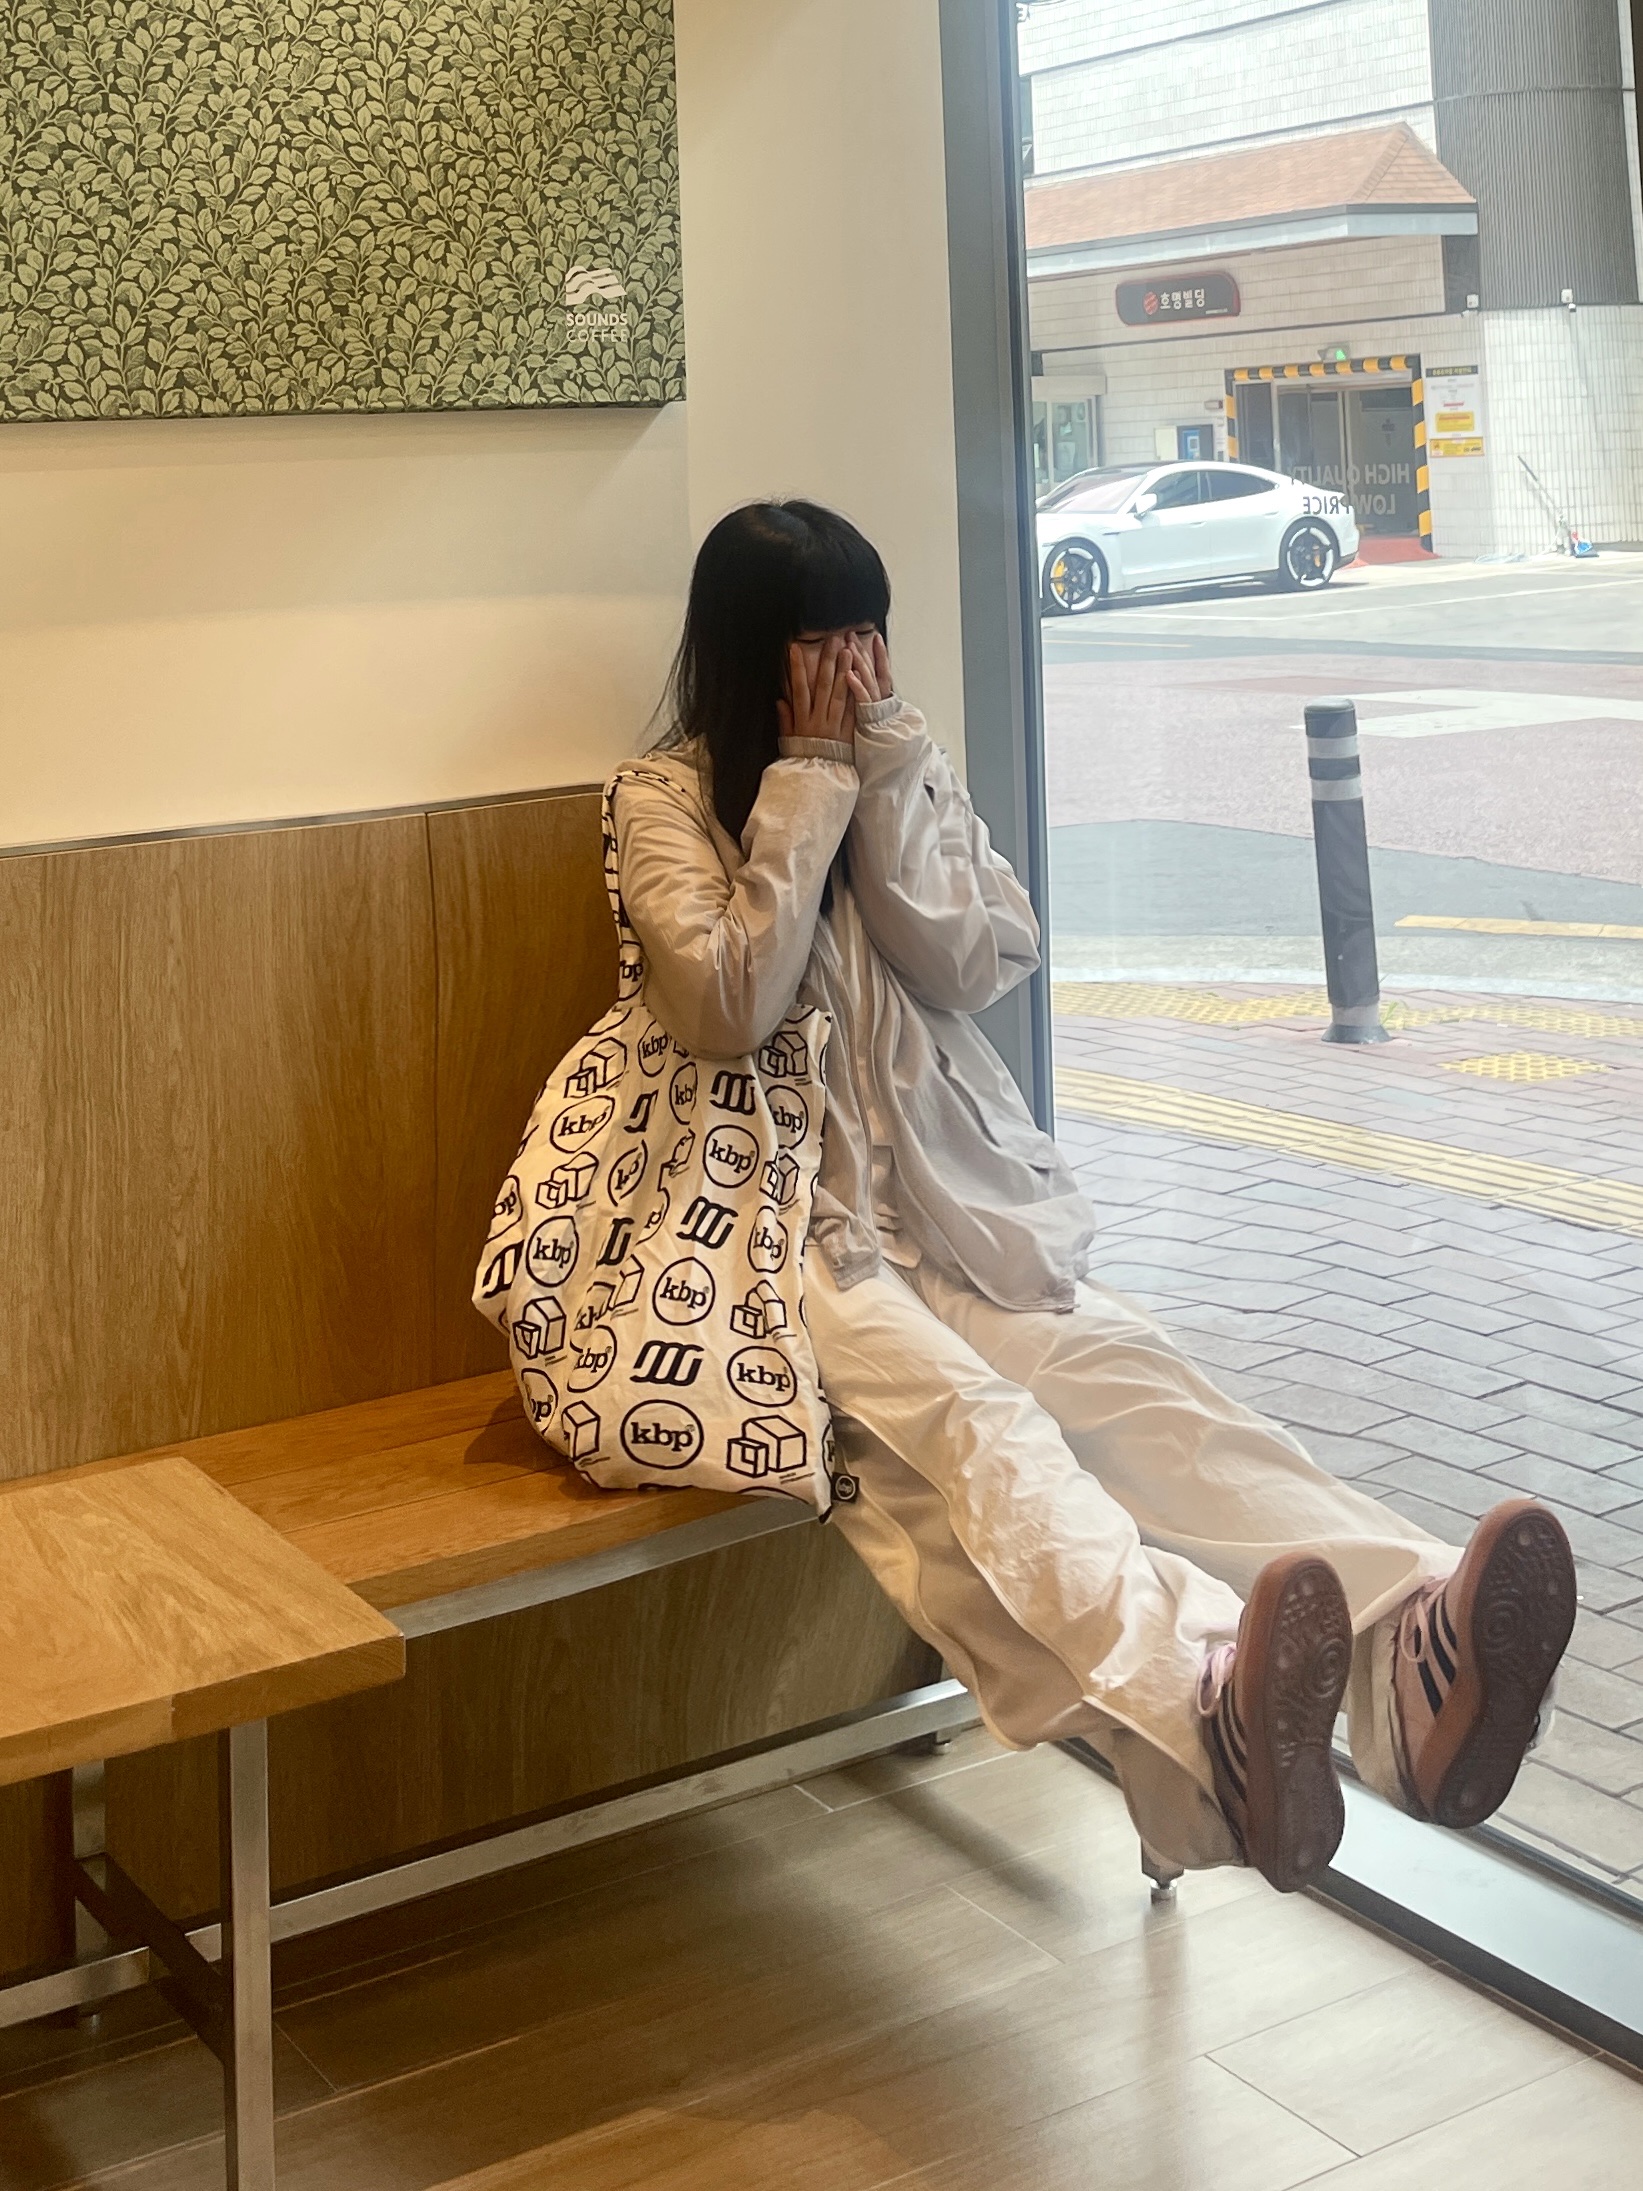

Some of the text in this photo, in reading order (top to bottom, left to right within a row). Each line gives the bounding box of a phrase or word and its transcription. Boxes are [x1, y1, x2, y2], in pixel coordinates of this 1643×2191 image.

[1160, 288, 1205, 310] 호명빌딩
[566, 313, 628, 326] SOUNDS
[566, 328, 628, 342] COFFEE
[620, 958, 643, 980] bp
[674, 1082, 697, 1105] kb
[709, 1138, 752, 1173] kbp
[533, 1237, 572, 1269] kbp
[660, 1277, 707, 1309] kbp
[737, 1362, 791, 1392] kbp
[631, 1422, 693, 1452] kbp
